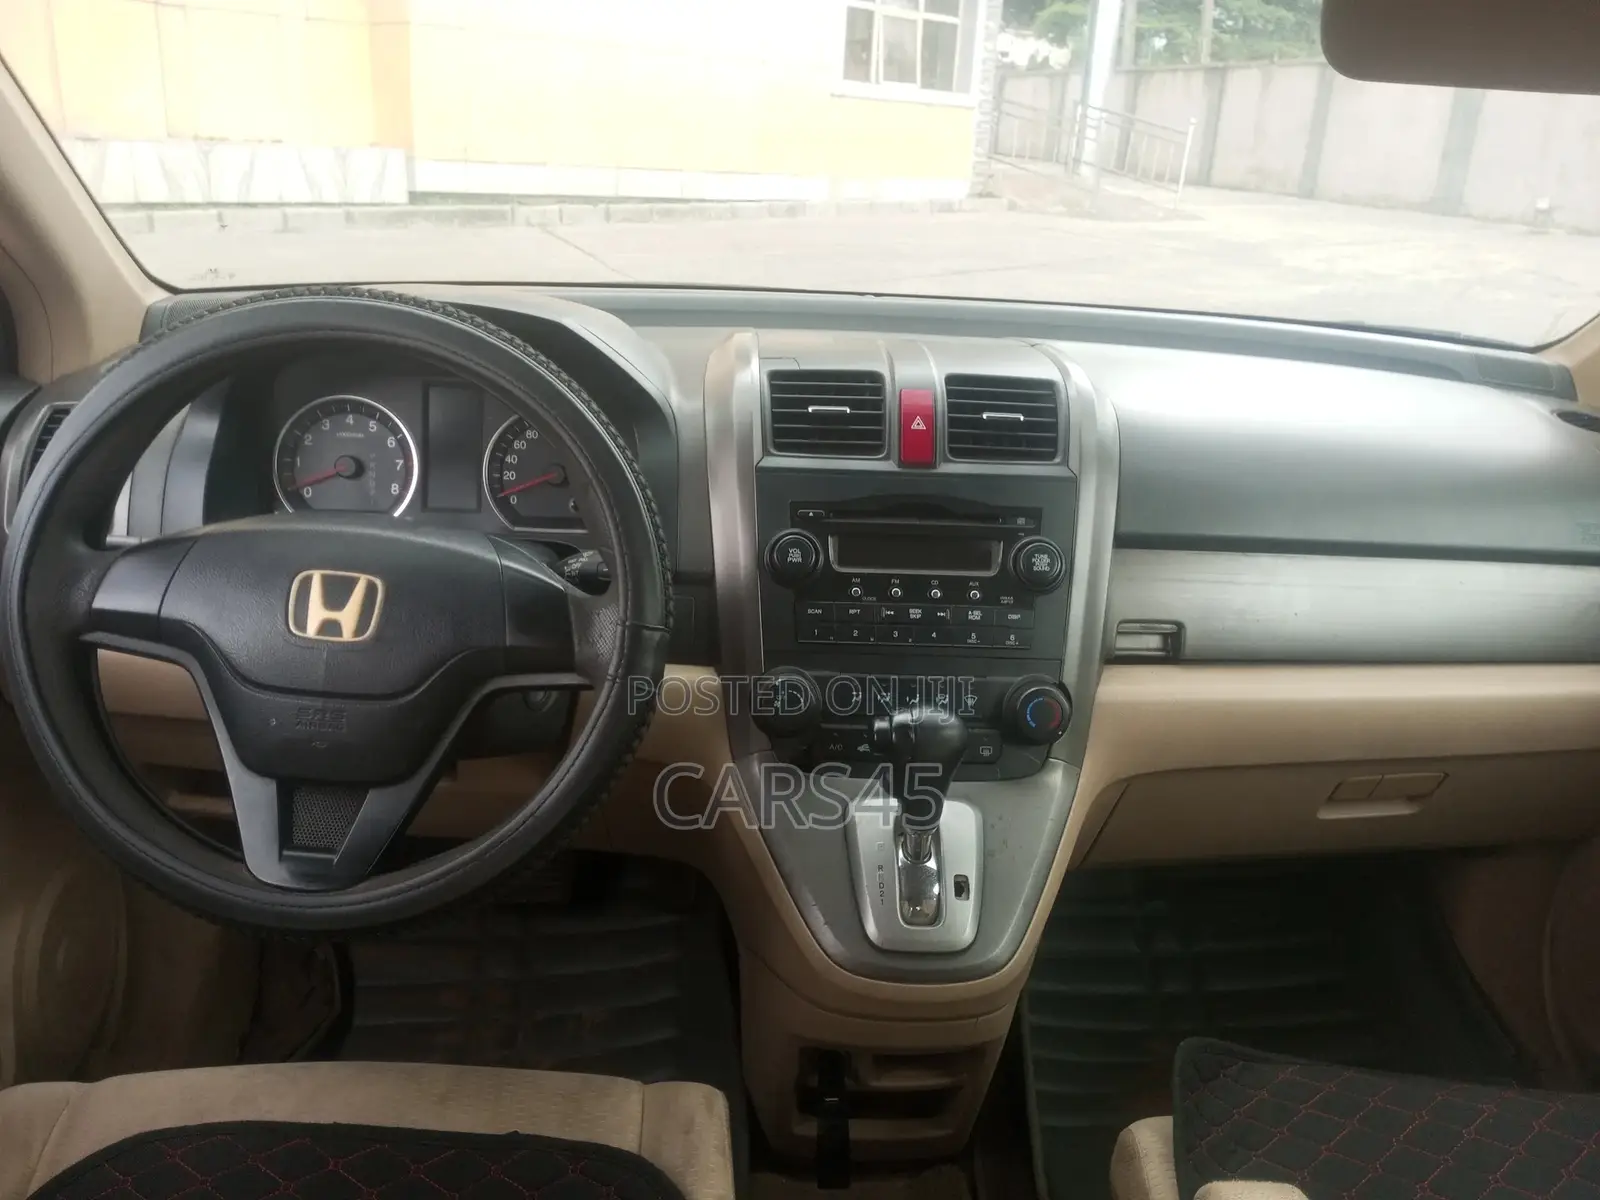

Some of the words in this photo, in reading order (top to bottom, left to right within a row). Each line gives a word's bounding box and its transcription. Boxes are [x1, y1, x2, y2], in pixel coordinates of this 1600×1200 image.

[346, 414, 354, 425] 4
[321, 420, 329, 430] 3
[368, 421, 376, 432] 5
[526, 430, 538, 438] 80
[304, 434, 312, 445] 2
[387, 437, 395, 448] 6
[514, 440, 526, 450] 60
[505, 455, 518, 464] 40
[396, 460, 404, 470] 7
[504, 471, 516, 480] 20
[304, 487, 312, 498] 0
[390, 484, 398, 494] 8
[510, 496, 517, 504] 0
